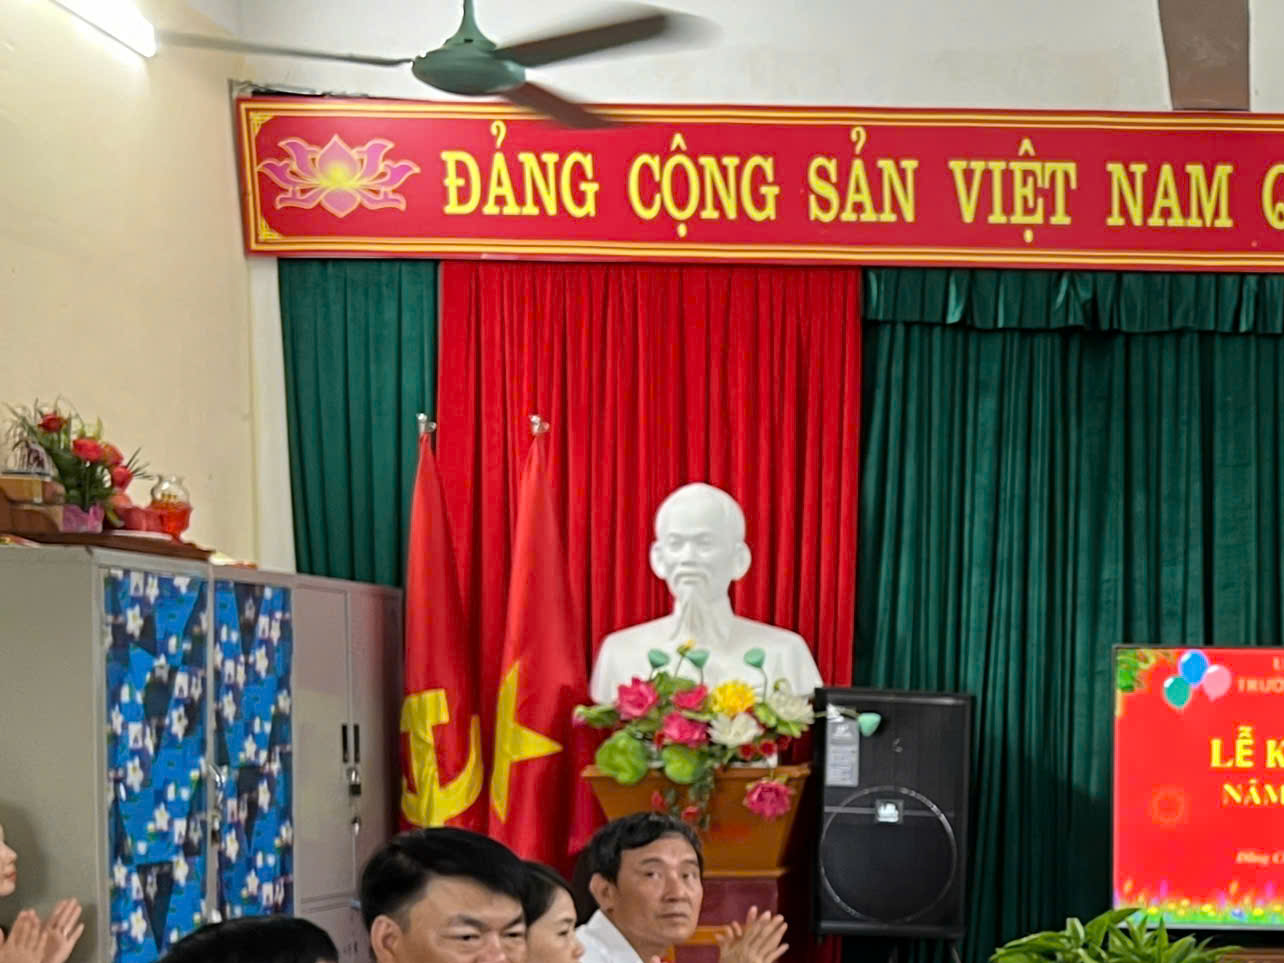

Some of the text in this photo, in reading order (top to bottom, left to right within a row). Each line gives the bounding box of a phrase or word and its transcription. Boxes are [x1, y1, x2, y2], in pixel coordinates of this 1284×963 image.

[443, 120, 599, 218] ĐẢNG
[629, 134, 779, 237] CỘNG
[808, 127, 918, 223] SẢN
[949, 139, 1077, 243] VIỆT
[1106, 163, 1234, 228] NAM
[1210, 725, 1255, 769] LỄ
